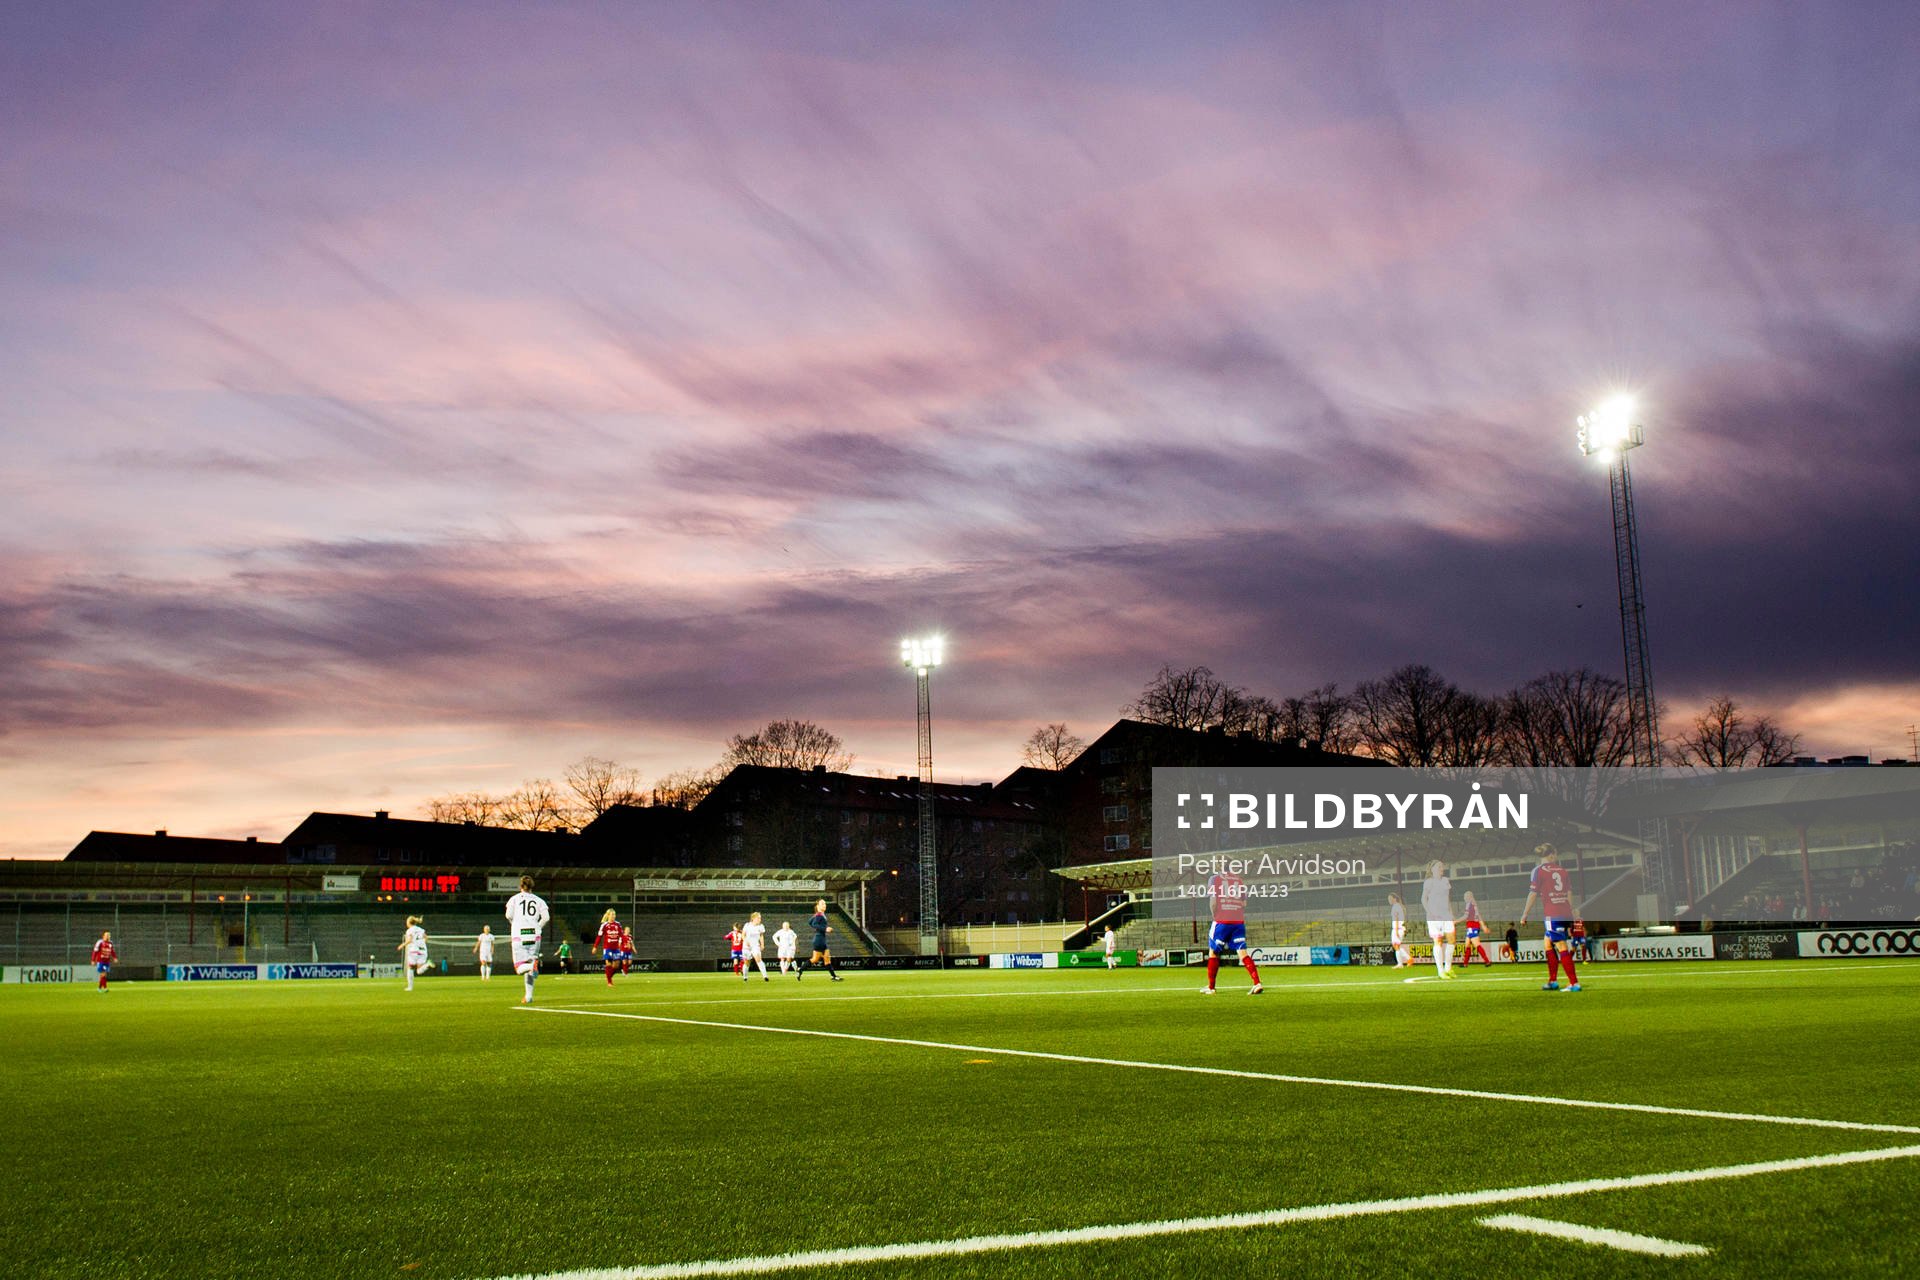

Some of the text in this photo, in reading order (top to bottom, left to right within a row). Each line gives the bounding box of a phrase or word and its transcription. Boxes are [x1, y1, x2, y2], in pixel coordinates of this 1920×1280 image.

[1552, 872, 1563, 891] 3
[520, 900, 537, 916] 16
[1250, 948, 1298, 961] Cavalet
[1621, 946, 1706, 959] SVENSKA SPEL
[28, 969, 67, 982] CAROLI
[199, 967, 256, 979] Wihlborgs
[299, 966, 354, 978] Wihlborgs
